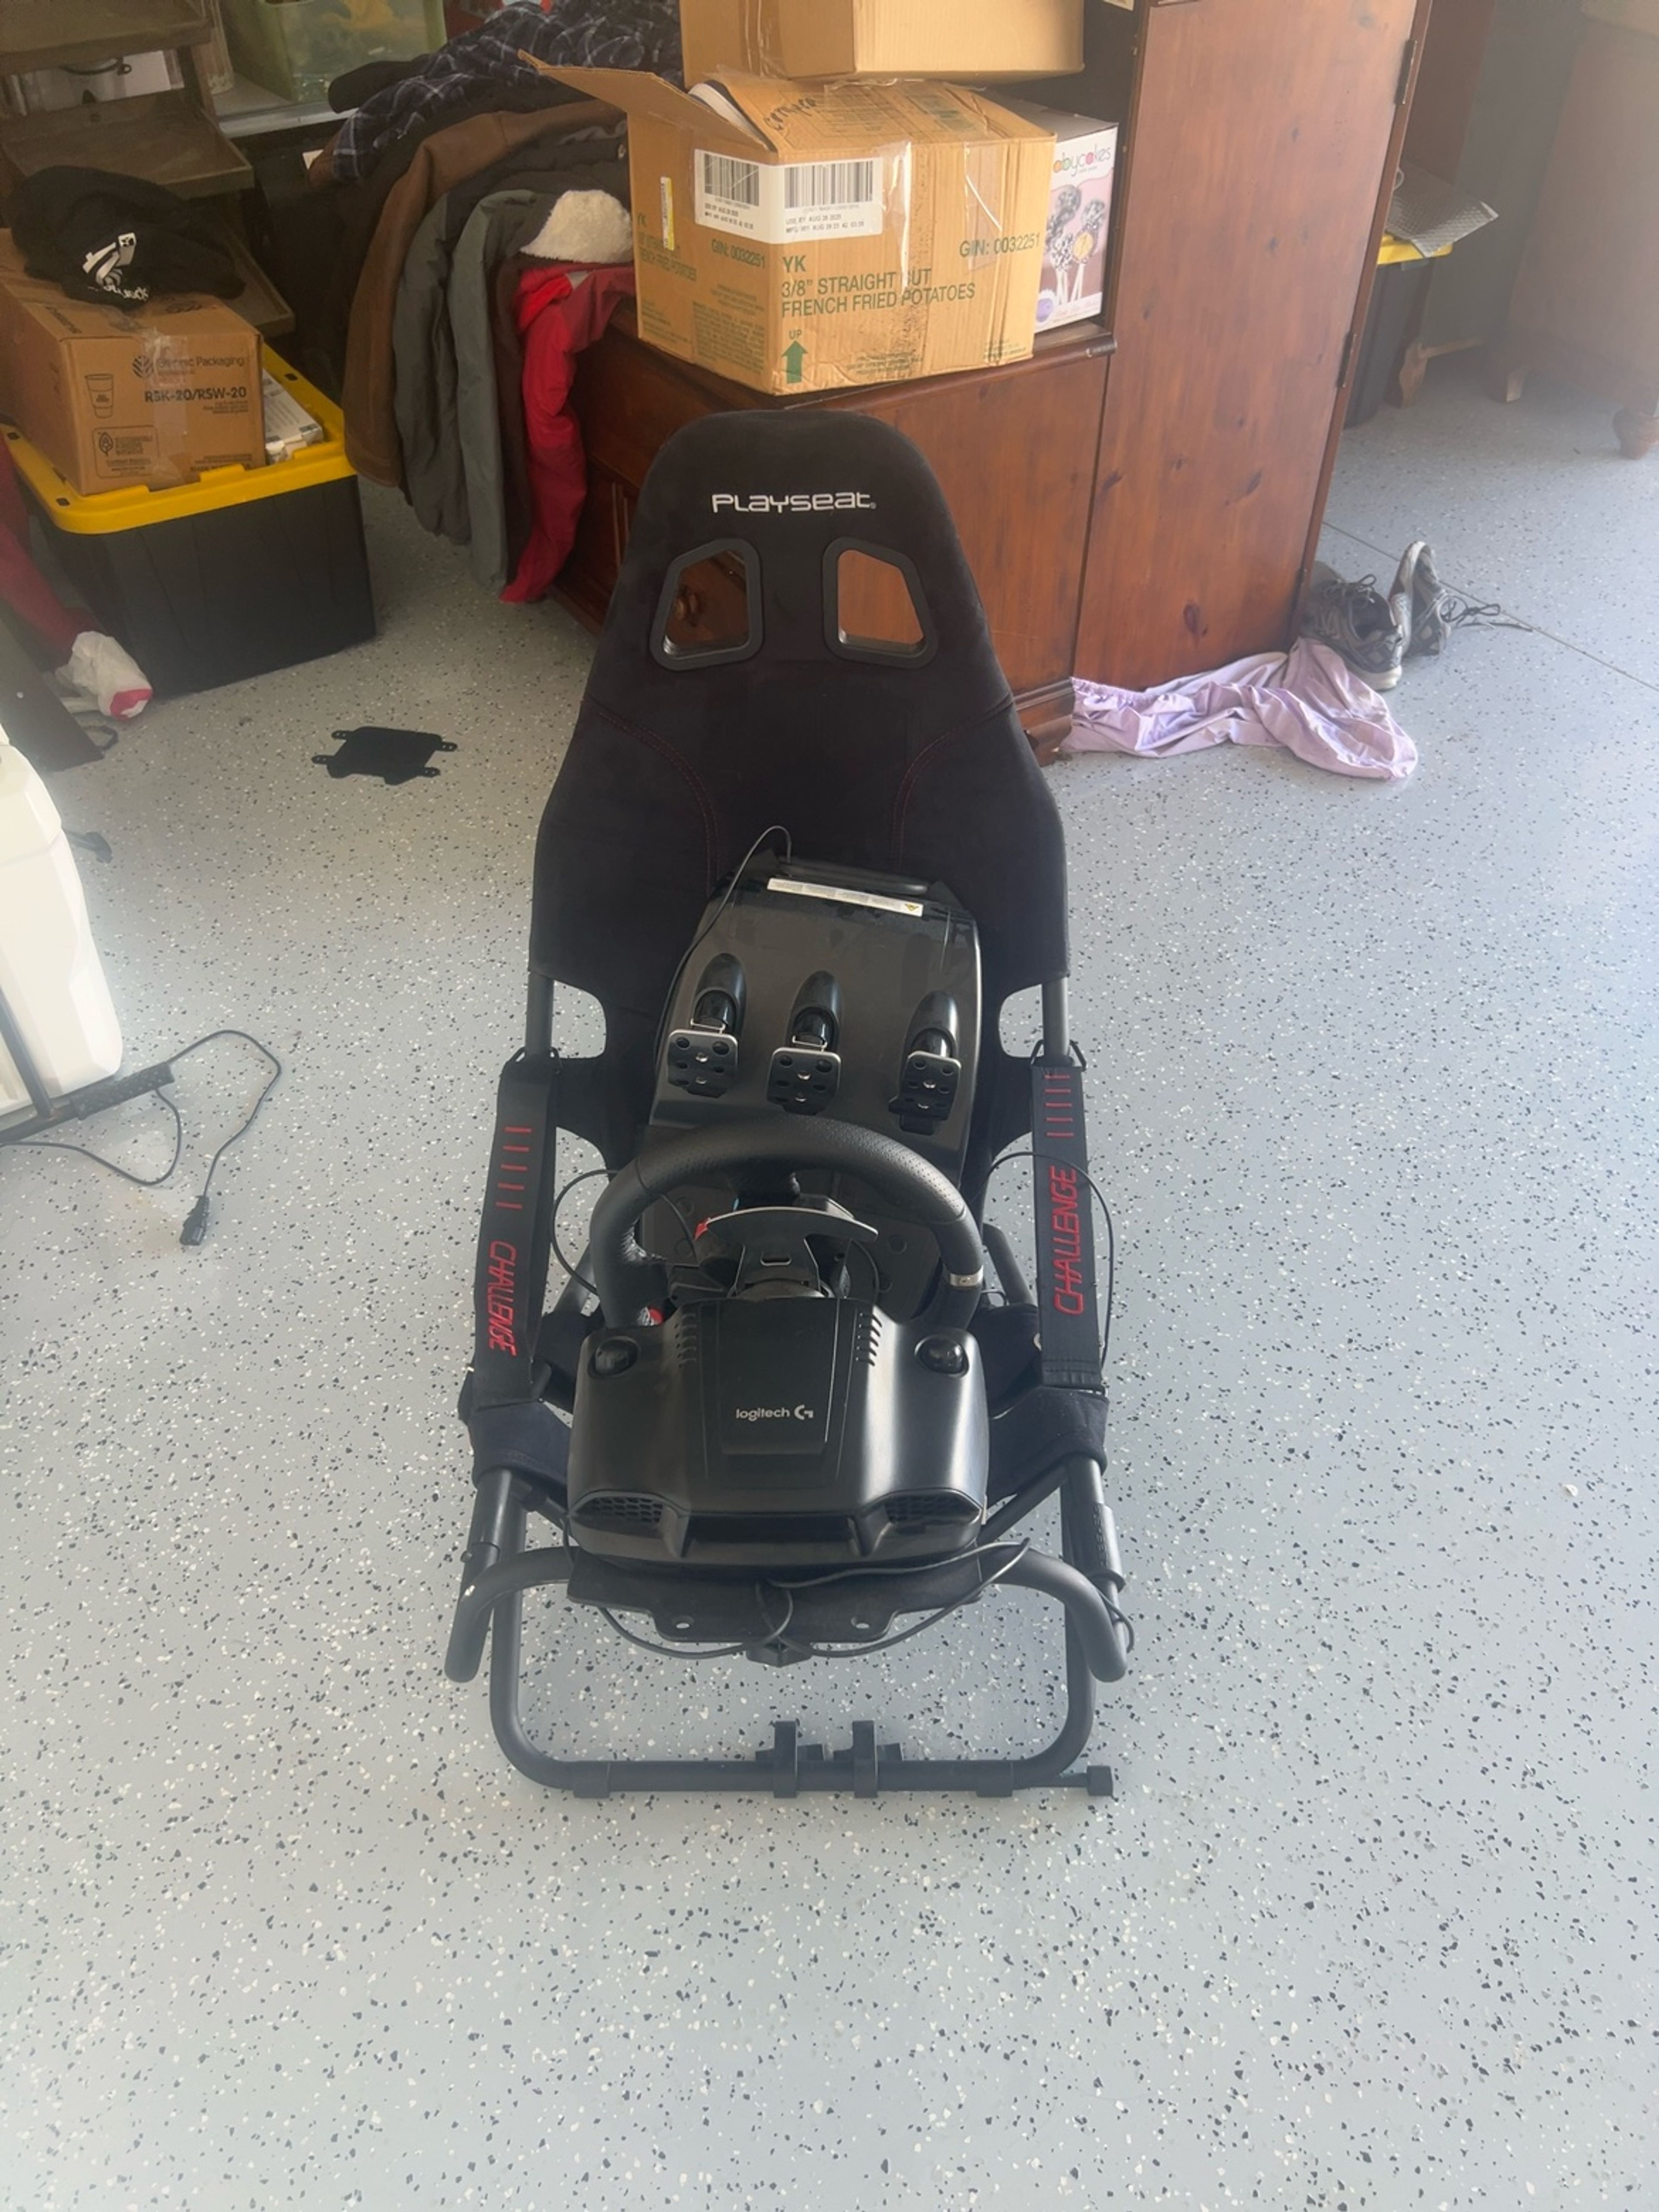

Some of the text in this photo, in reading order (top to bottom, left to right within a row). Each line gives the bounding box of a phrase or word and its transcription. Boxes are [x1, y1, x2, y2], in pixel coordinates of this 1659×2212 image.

[1053, 143, 1111, 177] abycakes
[994, 233, 1040, 254] 0032251
[782, 255, 806, 273] YK
[818, 272, 896, 295] STRAIGHT
[782, 296, 847, 318] FRENCH
[852, 292, 897, 311] FRIED
[901, 283, 976, 306] POTATOES
[789, 329, 802, 340] UP
[196, 356, 245, 367] Packaging
[1049, 1166, 1084, 1315] CHALLENGE
[488, 1240, 517, 1357] CHALLENGE
[736, 1407, 790, 1422] logitech
